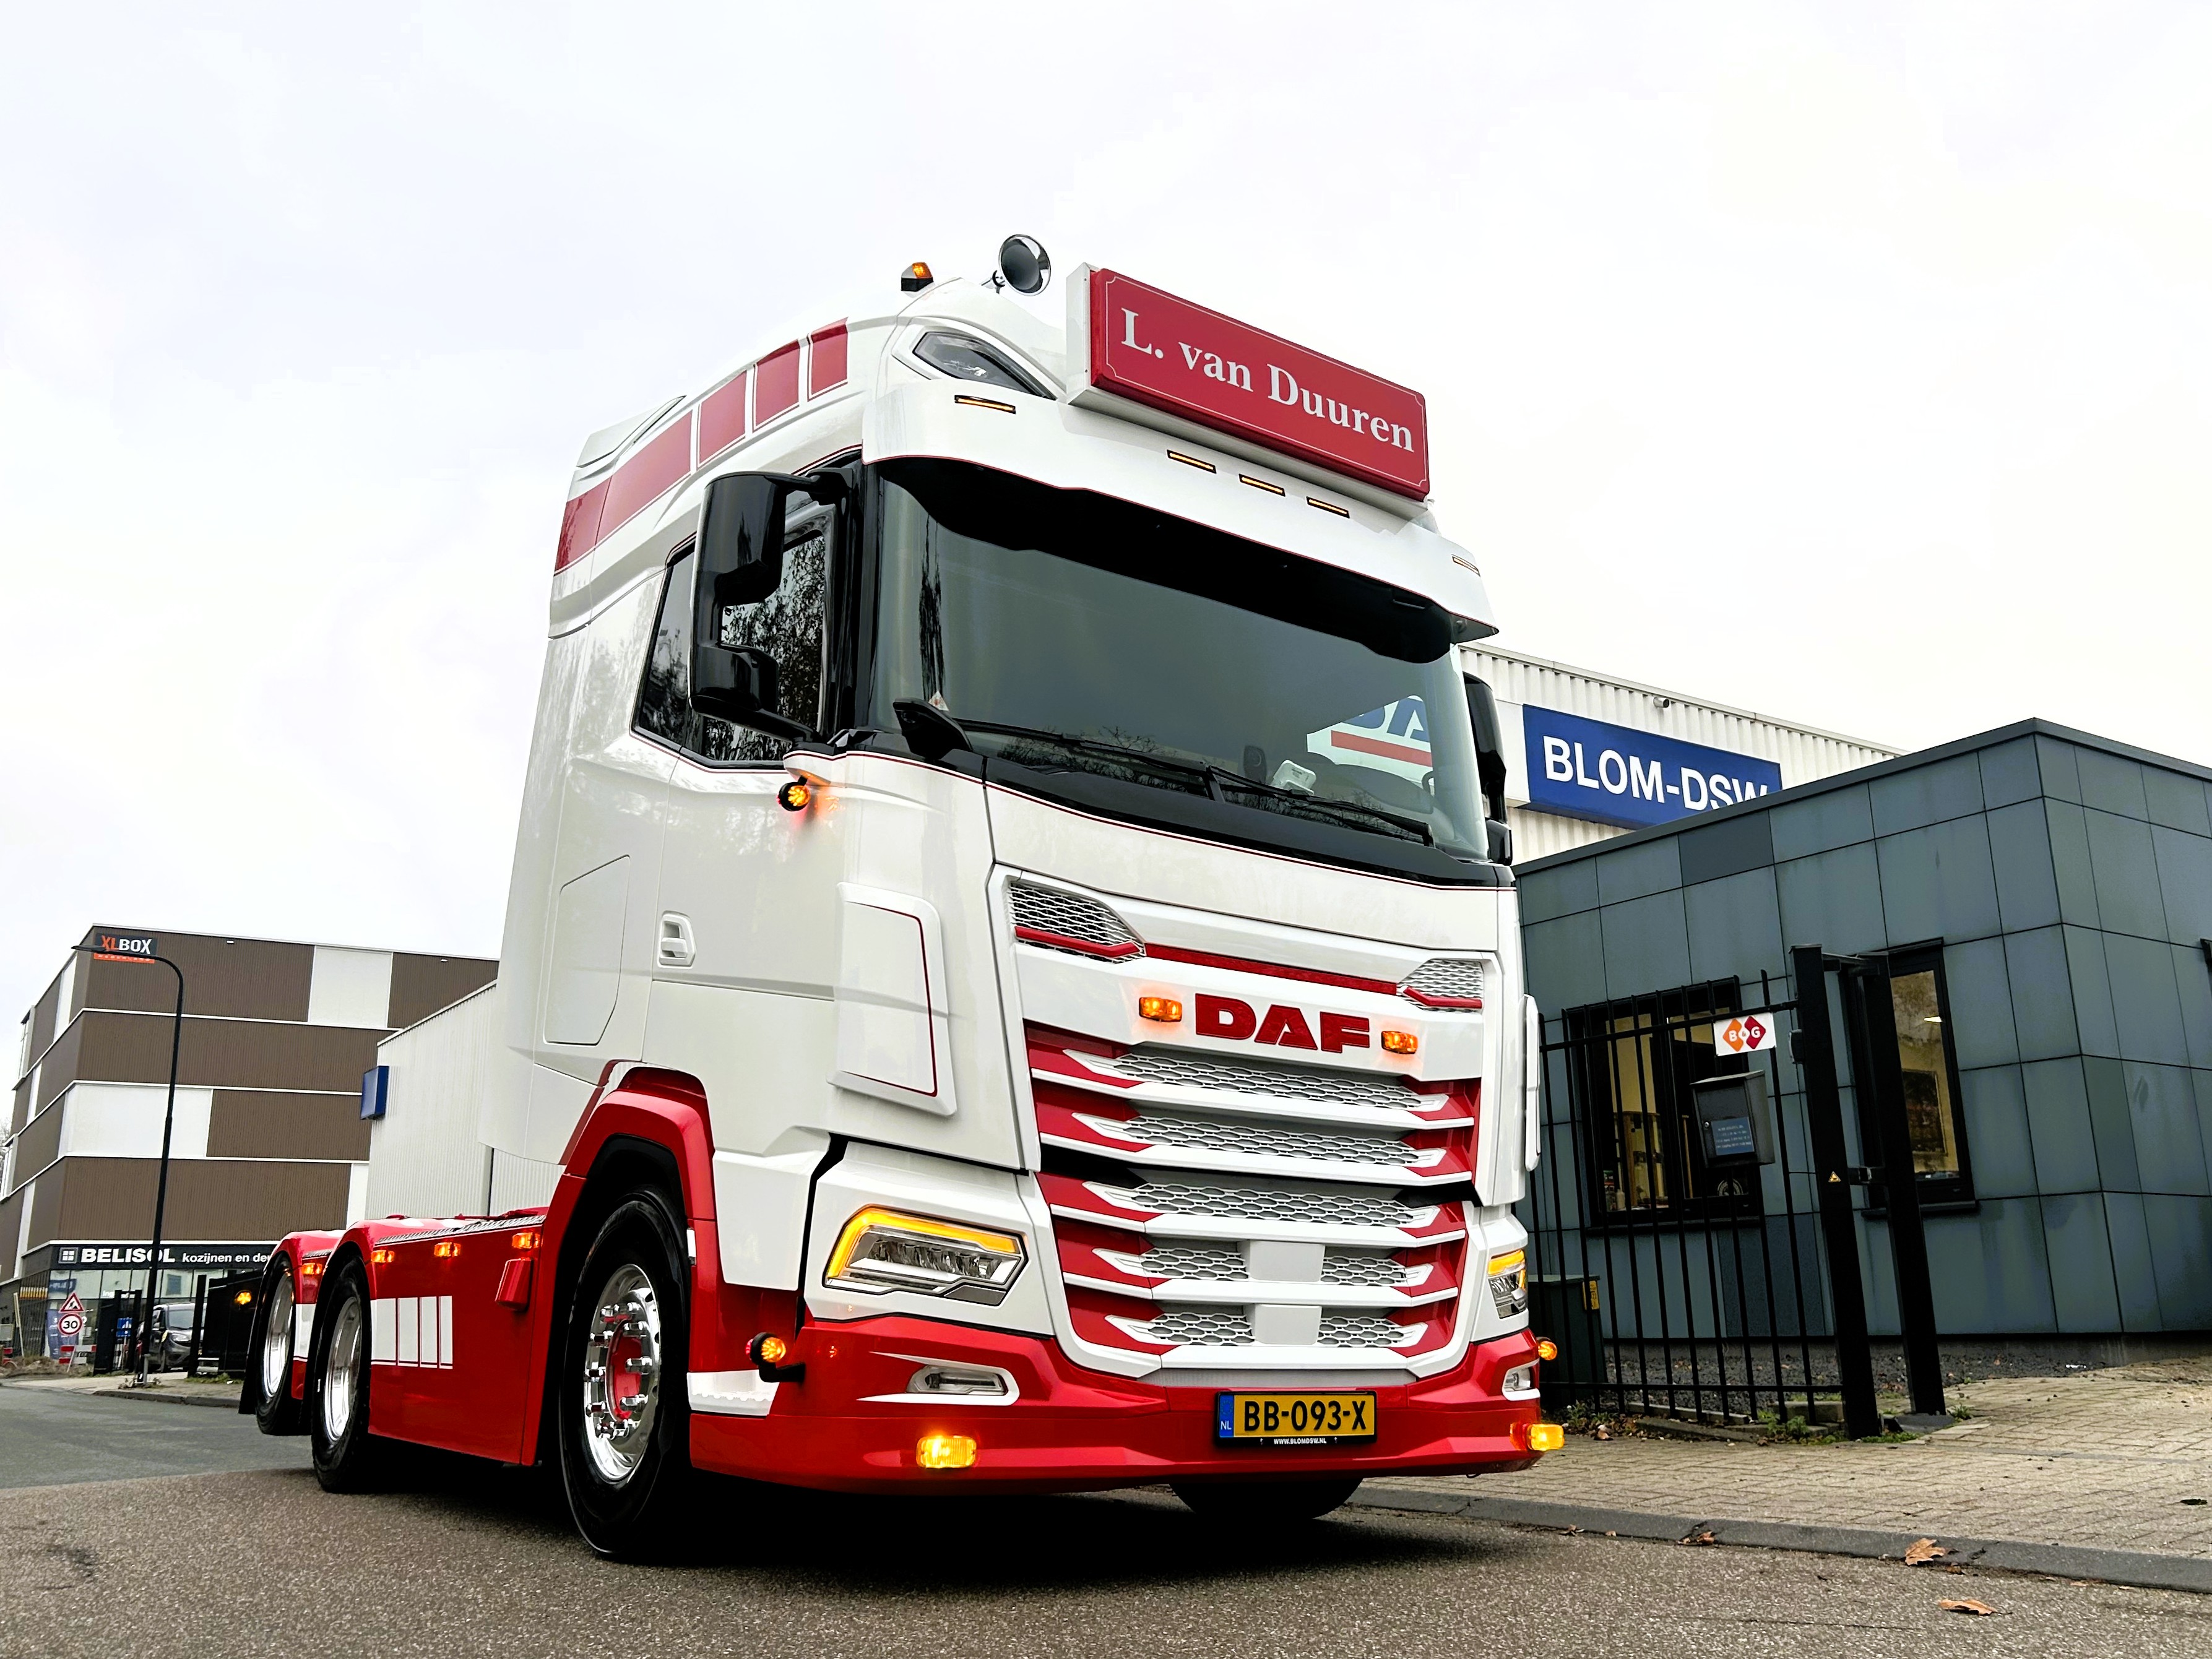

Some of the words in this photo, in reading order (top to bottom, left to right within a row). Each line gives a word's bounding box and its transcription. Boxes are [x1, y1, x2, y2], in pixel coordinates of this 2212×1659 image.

[1121, 308, 1164, 359] L.
[1179, 342, 1253, 392] van
[1267, 363, 1415, 452] Duuren
[1195, 993, 1370, 1053] DAF
[182, 1252, 231, 1264] kozijnen
[63, 1321, 78, 1329] 30
[1220, 1420, 1232, 1430] NL
[1245, 1400, 1367, 1431] BB-093-X
